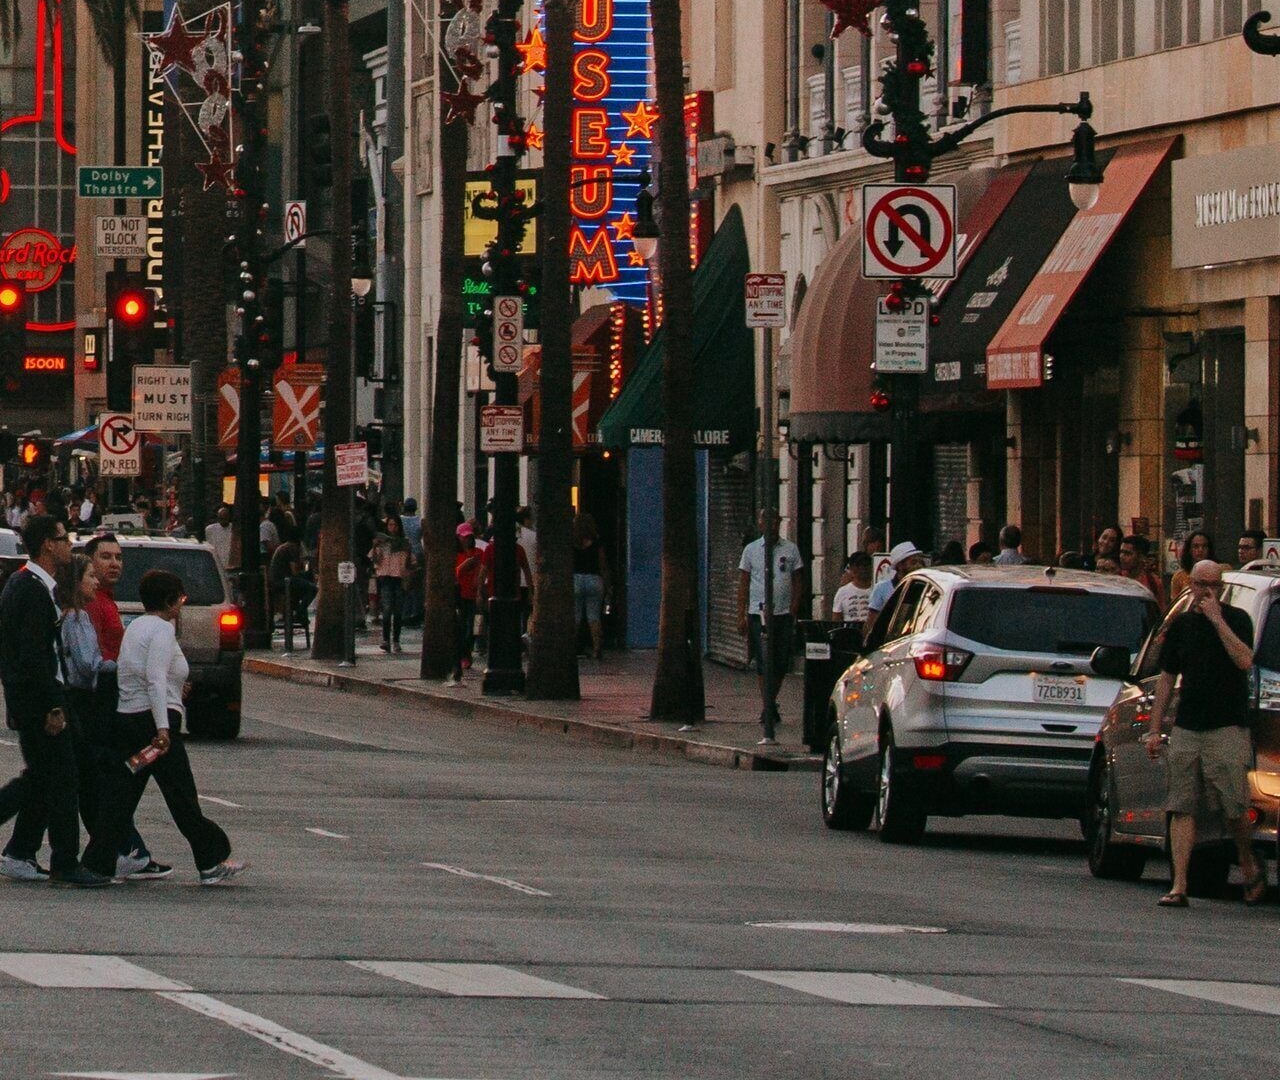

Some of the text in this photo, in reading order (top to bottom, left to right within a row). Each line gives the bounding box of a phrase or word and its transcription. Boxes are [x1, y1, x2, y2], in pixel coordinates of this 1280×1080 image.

[92, 171, 131, 183] Dolby
[85, 184, 138, 194] Theatre
[1195, 189, 1237, 228] MUSEUM
[102, 219, 140, 231] DO NOT
[105, 233, 137, 245] BLOCK
[98, 246, 145, 255] INTERSECTION
[746, 285, 758, 298] NO
[749, 300, 783, 309] ANY TIME
[879, 301, 925, 316] LPD
[138, 376, 190, 386] RIGHT LAN
[144, 394, 189, 405] MUST
[137, 412, 190, 421] TURN RIGH
[486, 428, 517, 436] ANY TIME
[630, 428, 730, 445] CAMER LORE
[103, 459, 137, 470] ON RED
[1037, 684, 1082, 699] 7ZCB931
